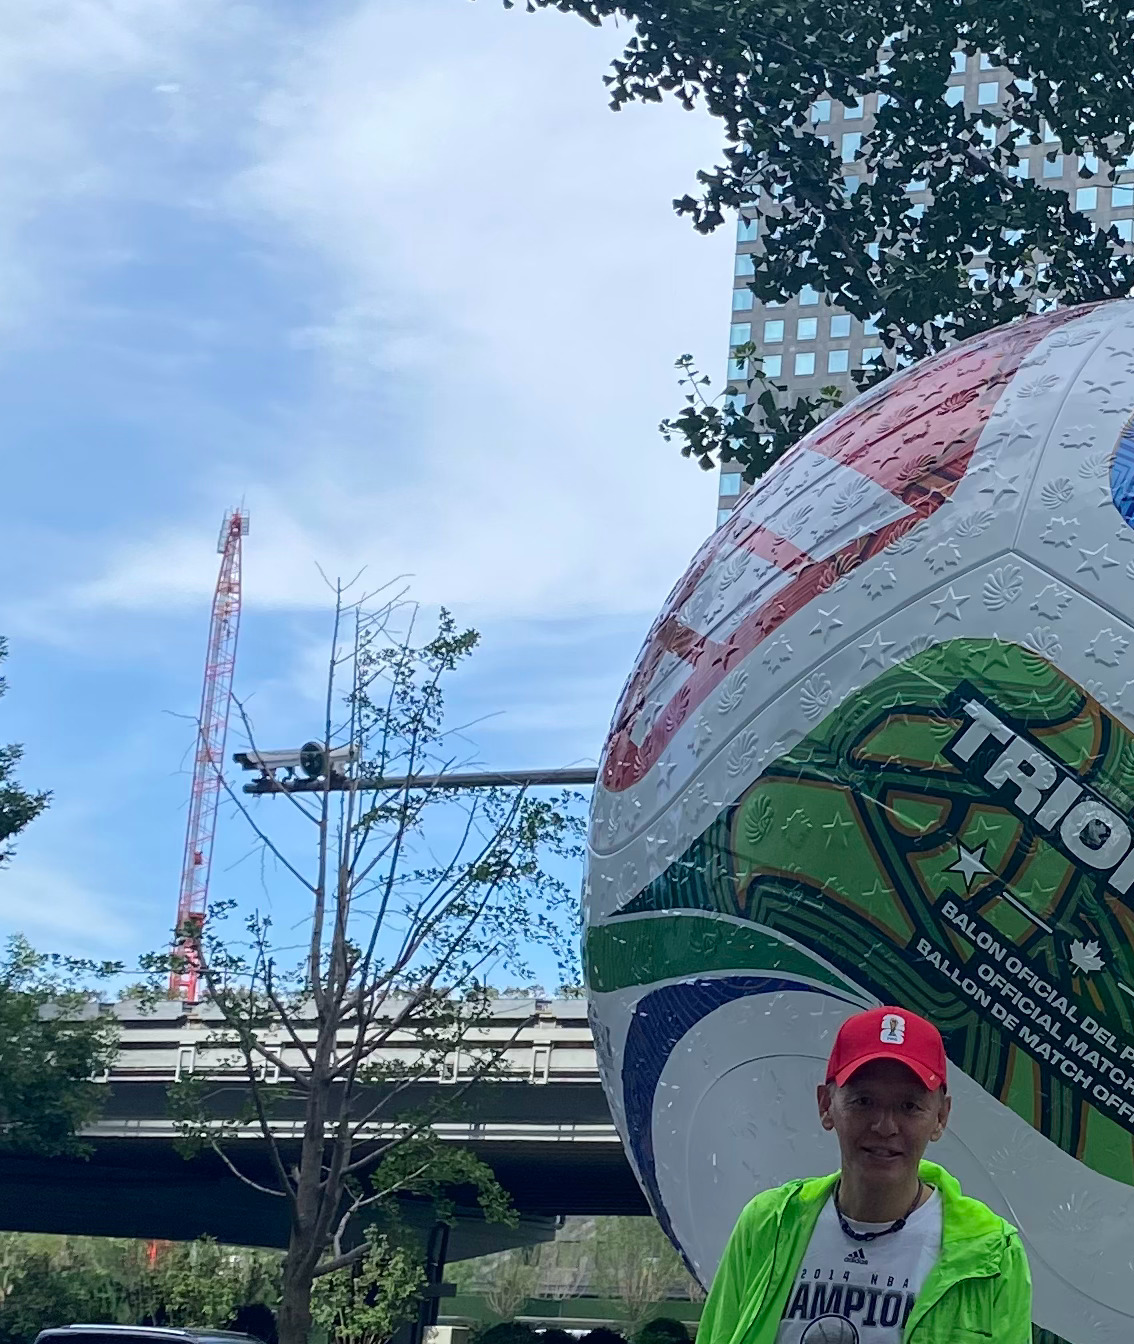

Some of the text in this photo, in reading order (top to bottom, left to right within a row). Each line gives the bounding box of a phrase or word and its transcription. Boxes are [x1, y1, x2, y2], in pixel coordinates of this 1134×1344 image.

[916, 937, 992, 1008] BALLON
[990, 1002, 1020, 1032] DE
[1018, 1025, 1094, 1090] MATCH
[941, 900, 1008, 962] BALON
[1005, 956, 1078, 1024] OFICIAL
[1080, 1015, 1118, 1053] DEL
[977, 963, 1062, 1041] OFFICIAL
[800, 1268, 909, 1288] 2014 NBA
